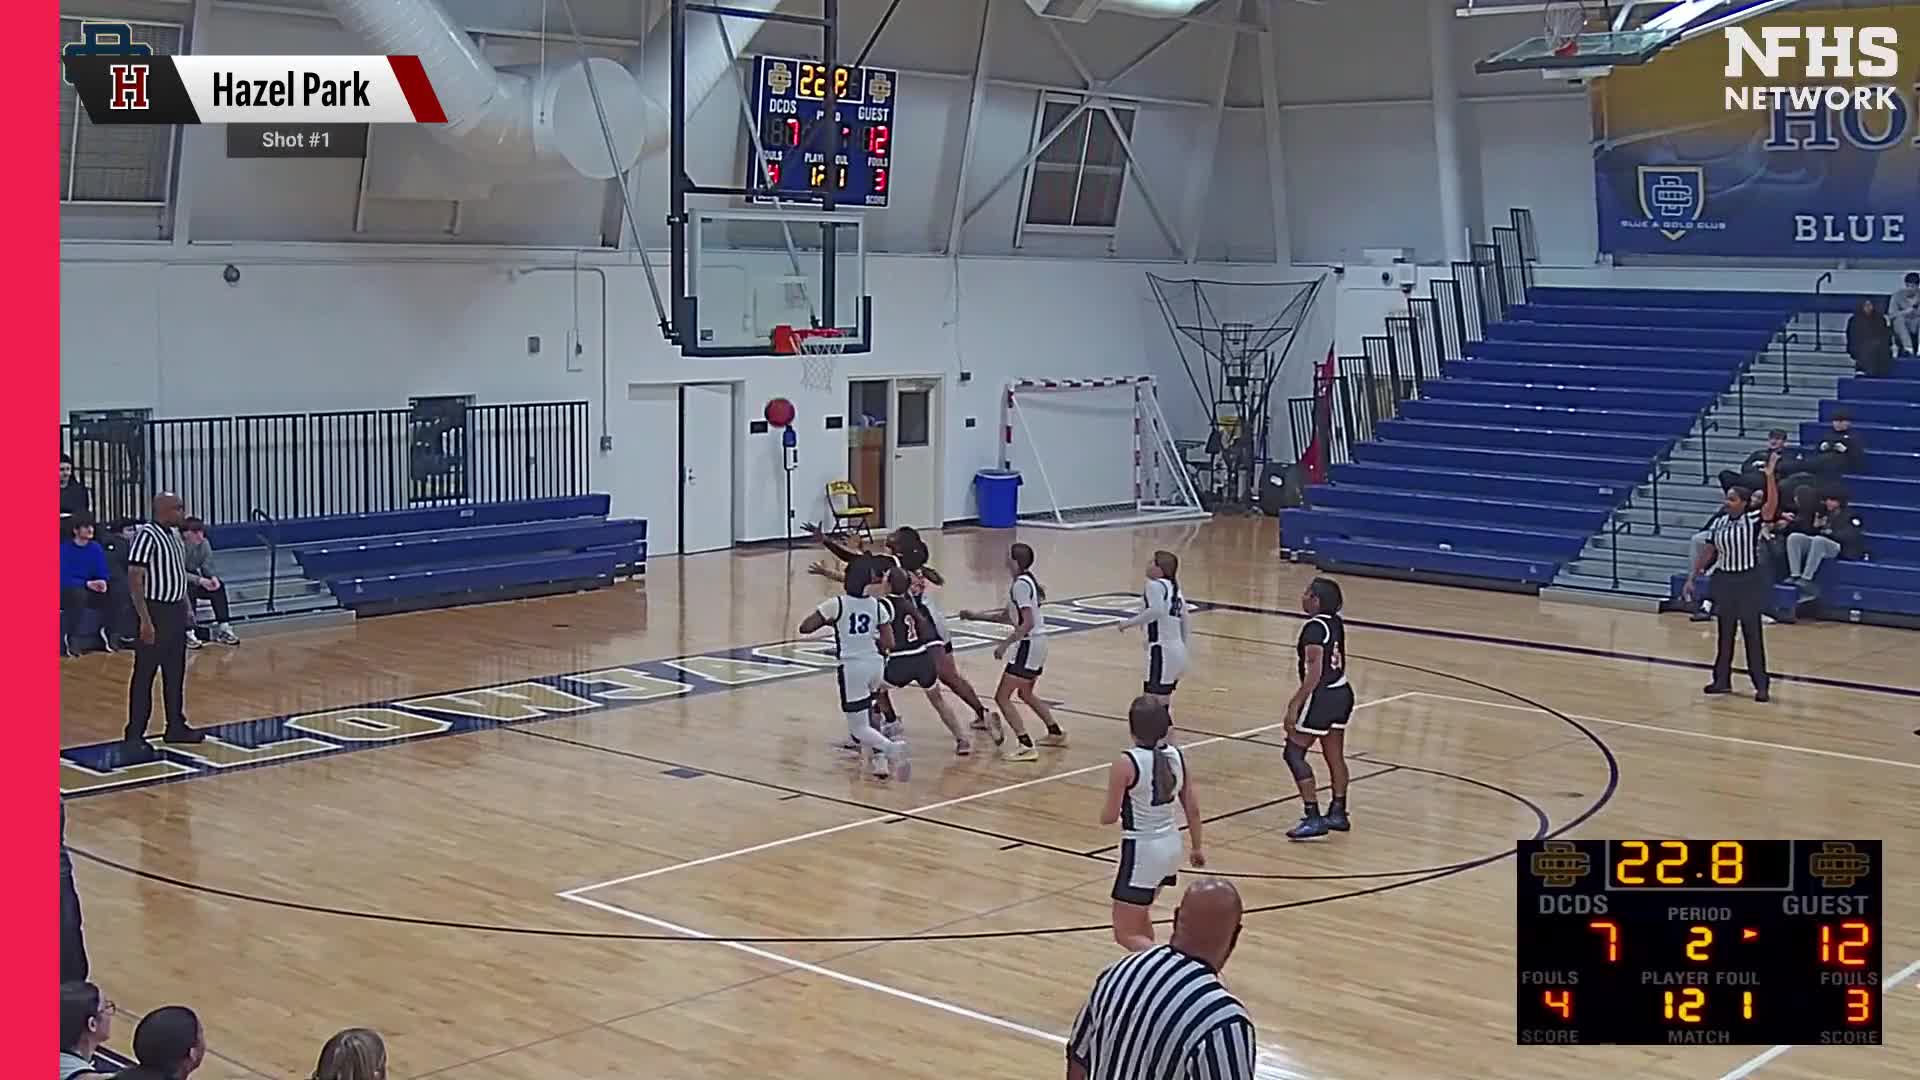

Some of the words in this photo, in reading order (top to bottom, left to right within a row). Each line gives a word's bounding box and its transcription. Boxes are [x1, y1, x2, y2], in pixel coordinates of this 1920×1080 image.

[769, 98, 797, 114] DCDS
[858, 106, 889, 122] GUEST
[1763, 82, 1920, 151] HO
[786, 118, 800, 146] 7
[868, 125, 889, 154] 12
[1794, 215, 1905, 242] BLUE
[848, 612, 870, 635] 13
